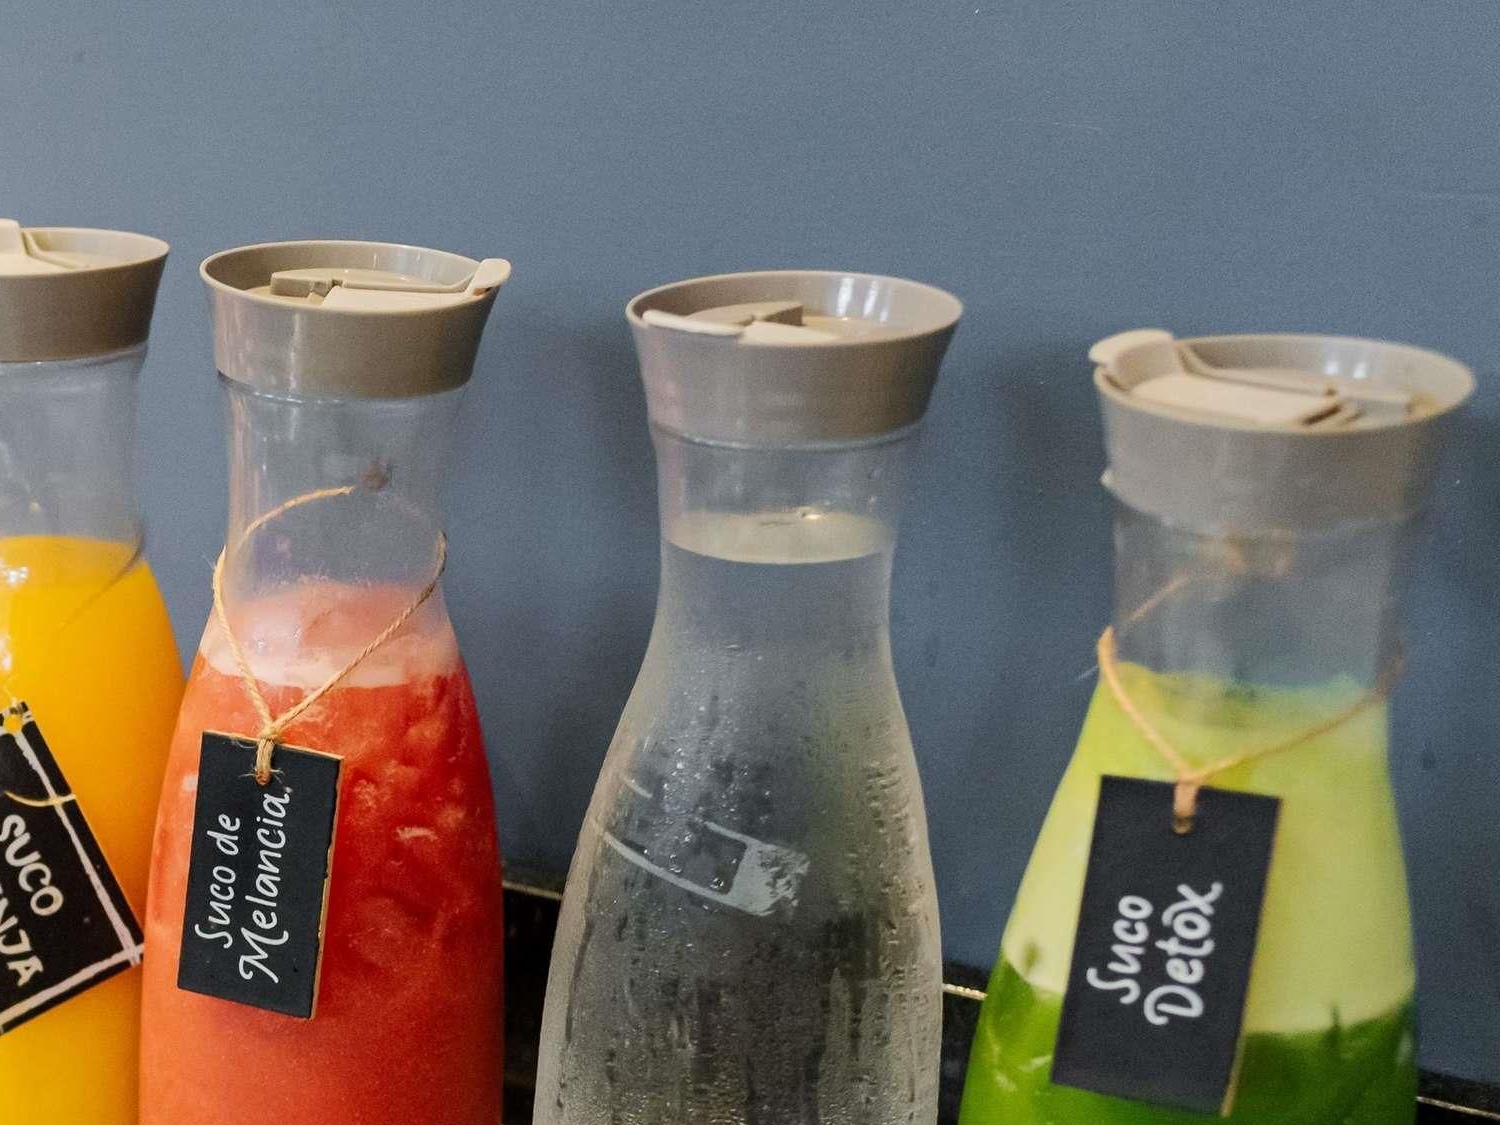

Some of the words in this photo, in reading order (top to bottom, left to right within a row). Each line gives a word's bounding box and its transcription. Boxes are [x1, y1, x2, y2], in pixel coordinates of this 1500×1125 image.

[206, 812, 242, 859] de
[194, 866, 238, 950] Suco
[238, 791, 292, 984] Melancia
[1085, 894, 1154, 1005] Suco
